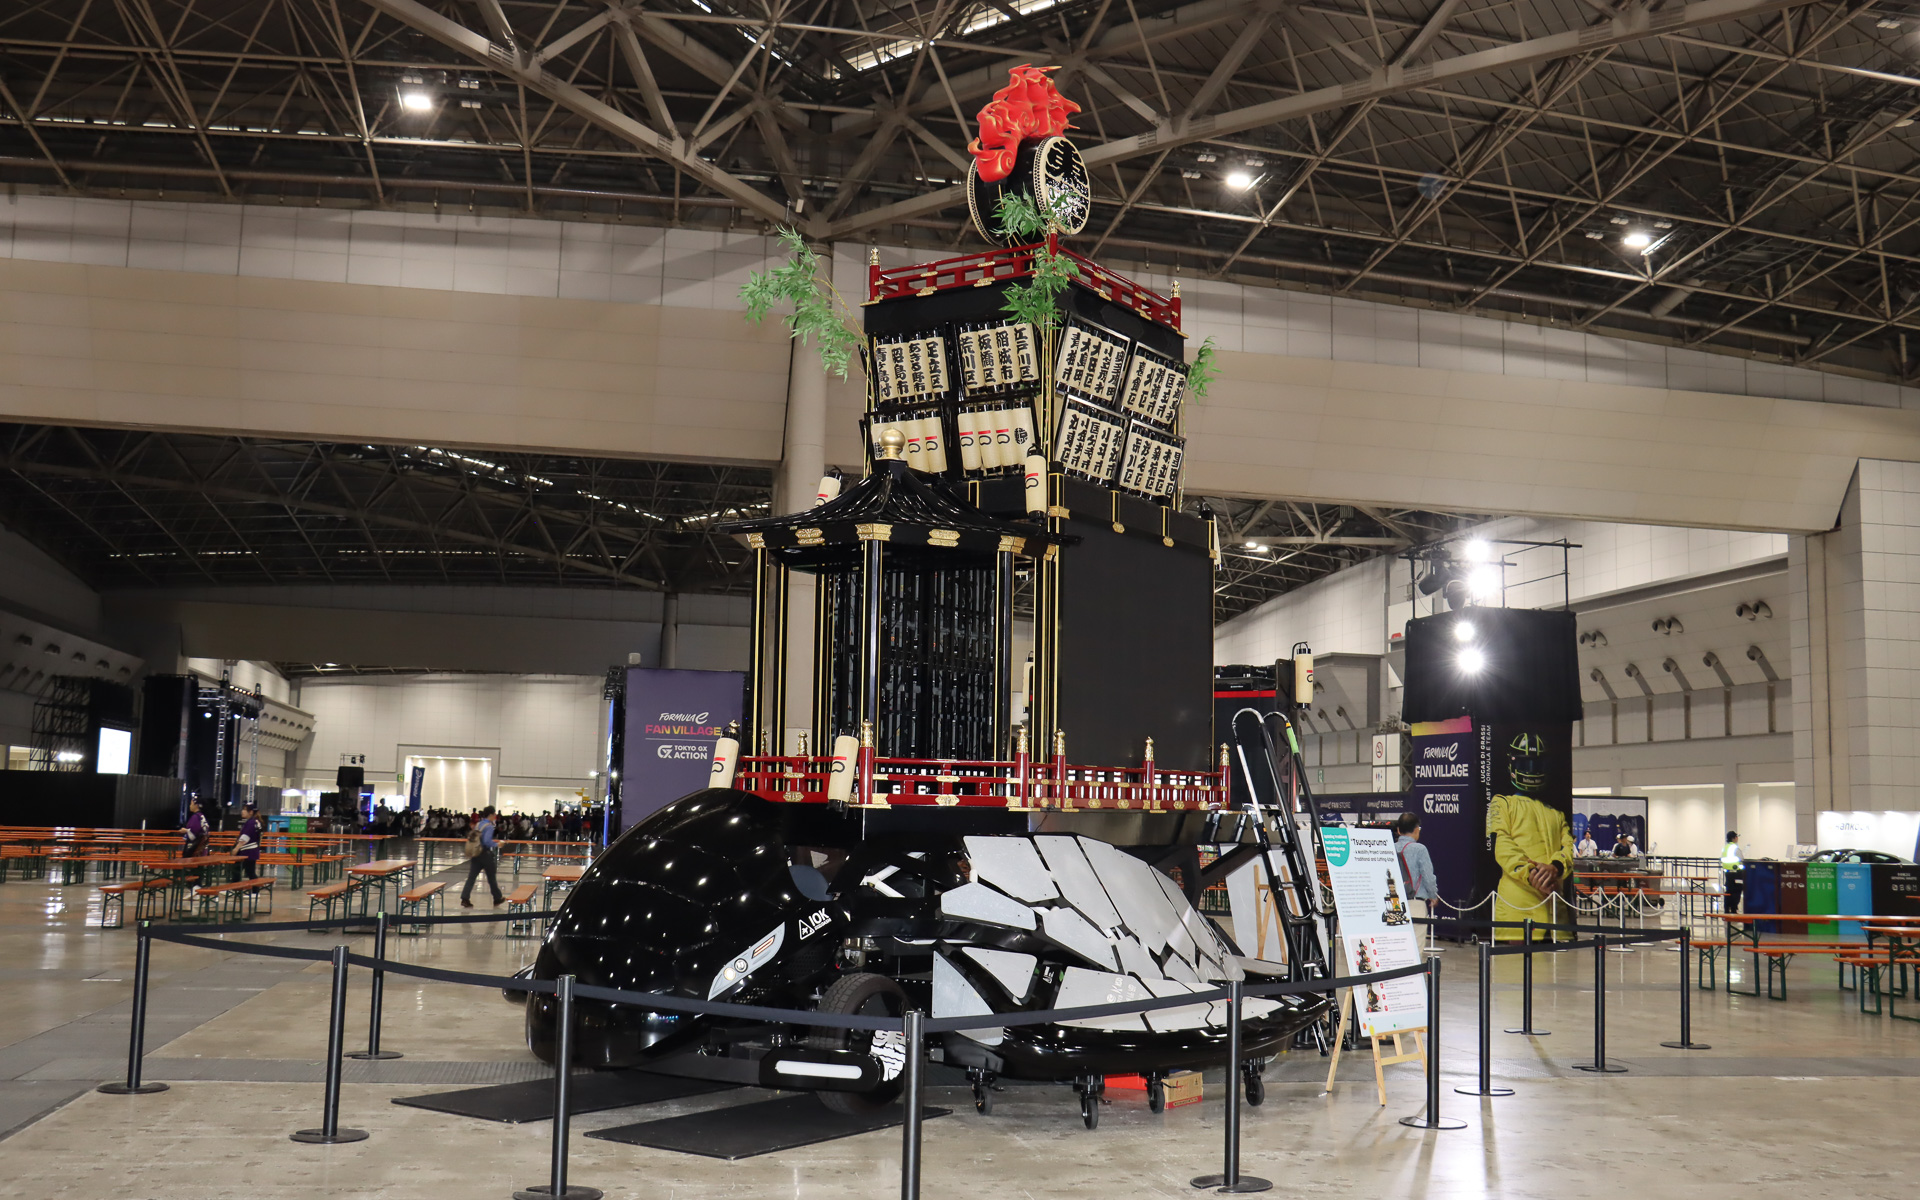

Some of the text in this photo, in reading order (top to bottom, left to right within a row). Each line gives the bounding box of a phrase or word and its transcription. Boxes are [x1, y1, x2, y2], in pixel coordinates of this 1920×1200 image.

[892, 347, 909, 395] 昭島市
[909, 343, 925, 392] あきる野市
[926, 341, 943, 389] 足立区
[960, 336, 978, 385] 荒川区
[978, 333, 996, 382] 板橋区
[996, 330, 1013, 380] 稲城市
[1014, 327, 1034, 378] 江戸川区
[1062, 332, 1080, 381] 青梅市
[1084, 341, 1101, 388] 大田区
[1156, 373, 1176, 418] 国立市
[1060, 414, 1079, 463] 江東区
[1071, 418, 1090, 467] 小金井市
[1081, 421, 1100, 470] 国分寺市
[1123, 438, 1142, 483] 品川区
[645, 724, 721, 736] FAN VILLAGE
[659, 712, 696, 722] FORMULA
[674, 752, 708, 760] ACTION
[1415, 763, 1469, 778] FAN VILLAGE
[1423, 746, 1449, 759] FORMULA
[1390, 800, 1404, 808] STORE
[1435, 793, 1459, 801] TOKYO GX
[1435, 803, 1459, 813] ACTION
